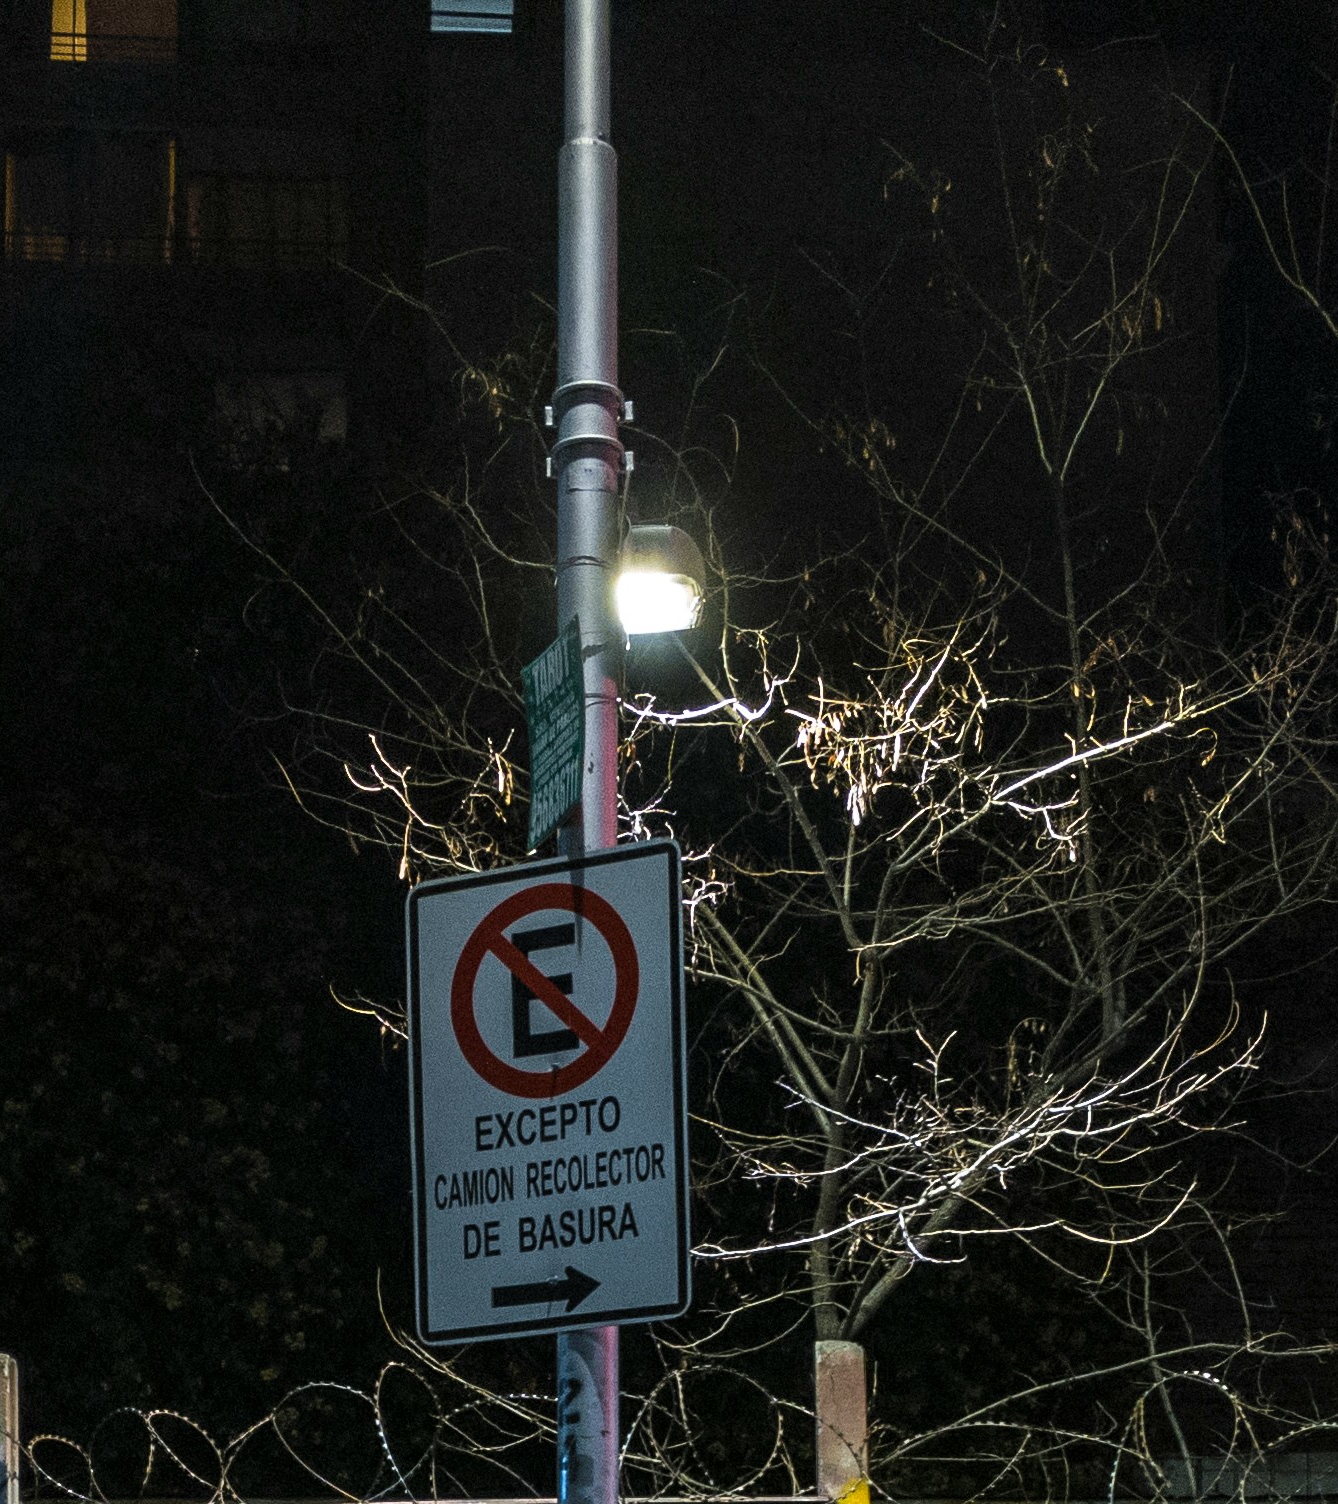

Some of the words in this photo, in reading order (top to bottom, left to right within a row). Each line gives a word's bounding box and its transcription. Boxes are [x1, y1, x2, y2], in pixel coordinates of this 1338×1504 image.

[531, 634, 570, 706] TAROT
[511, 922, 580, 1060] E
[475, 1095, 621, 1151] EXCEPTO
[434, 1165, 514, 1210] CAMION
[526, 1143, 666, 1199] RECOLECTOR
[463, 1220, 501, 1260] DE
[518, 1202, 640, 1253] BASURA
